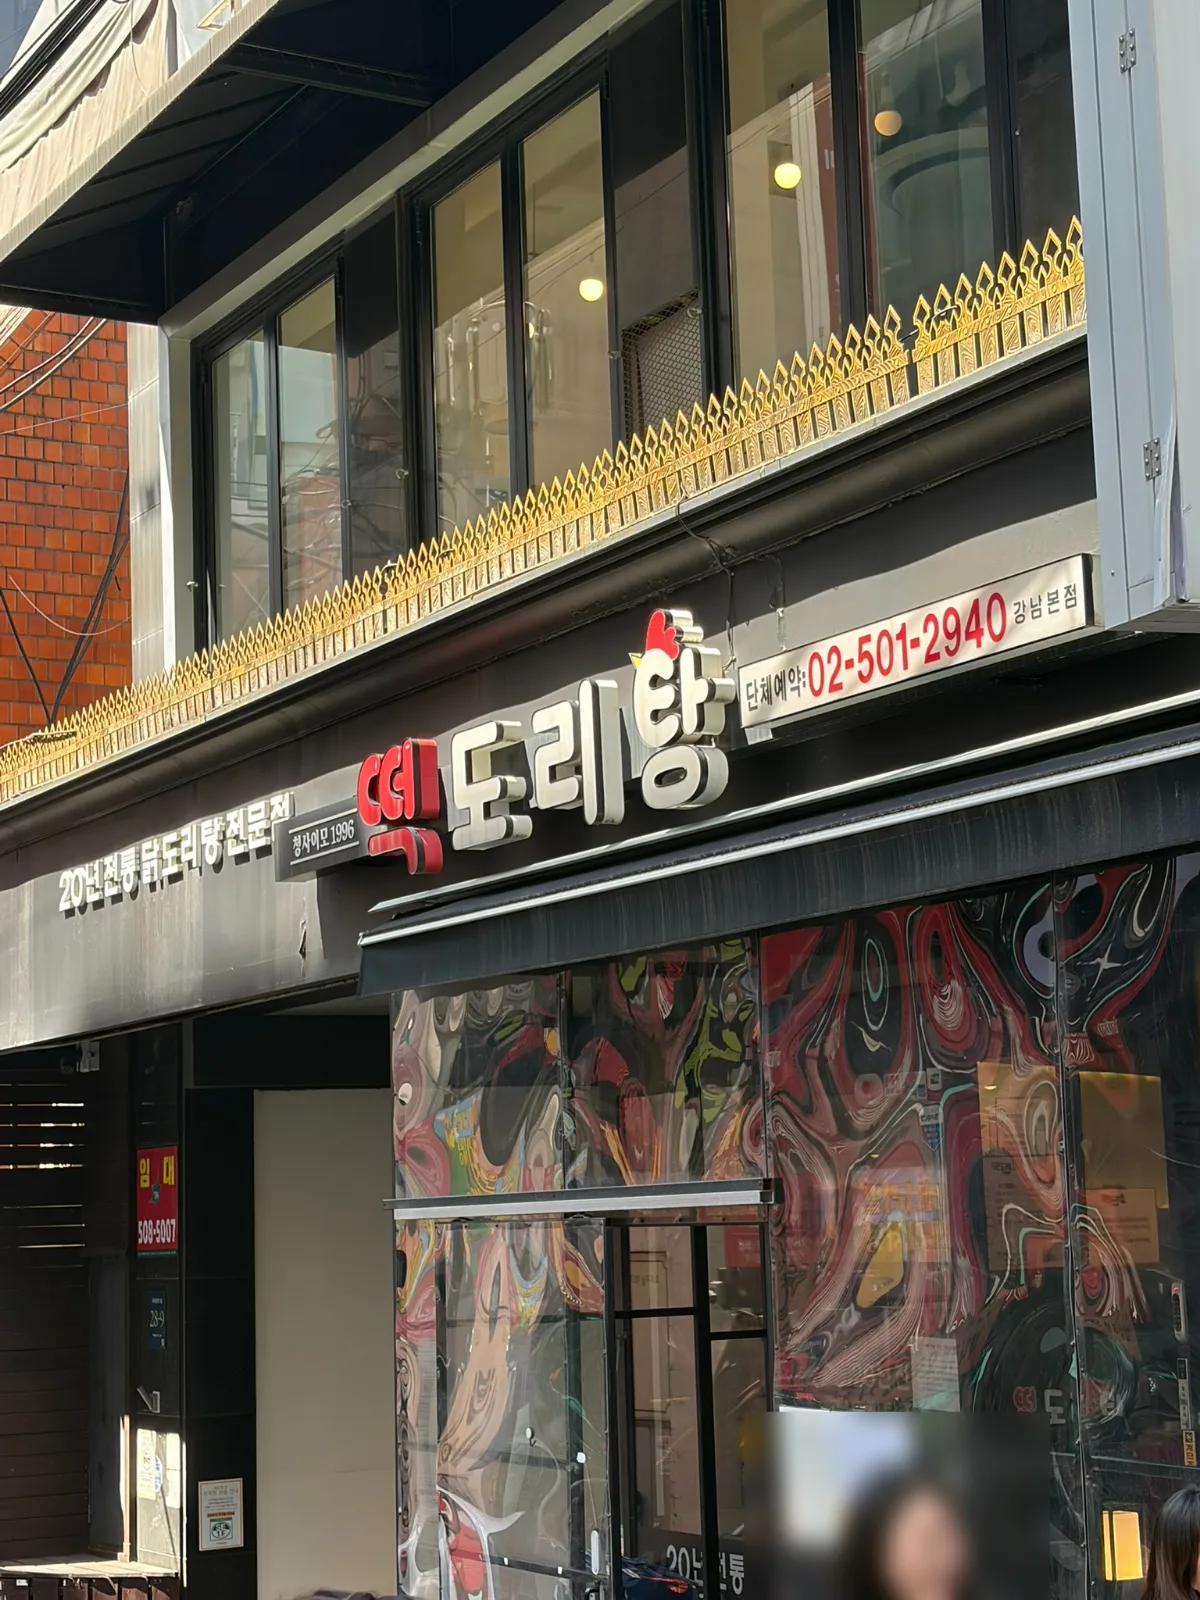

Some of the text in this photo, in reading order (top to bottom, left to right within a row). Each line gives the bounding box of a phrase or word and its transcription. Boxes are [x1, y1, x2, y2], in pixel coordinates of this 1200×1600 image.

[745, 583, 1078, 712] 단체예약: 02-501-2940 강남본점
[357, 612, 735, 875] 떡도리탕
[292, 819, 355, 857] 청사이모 1996
